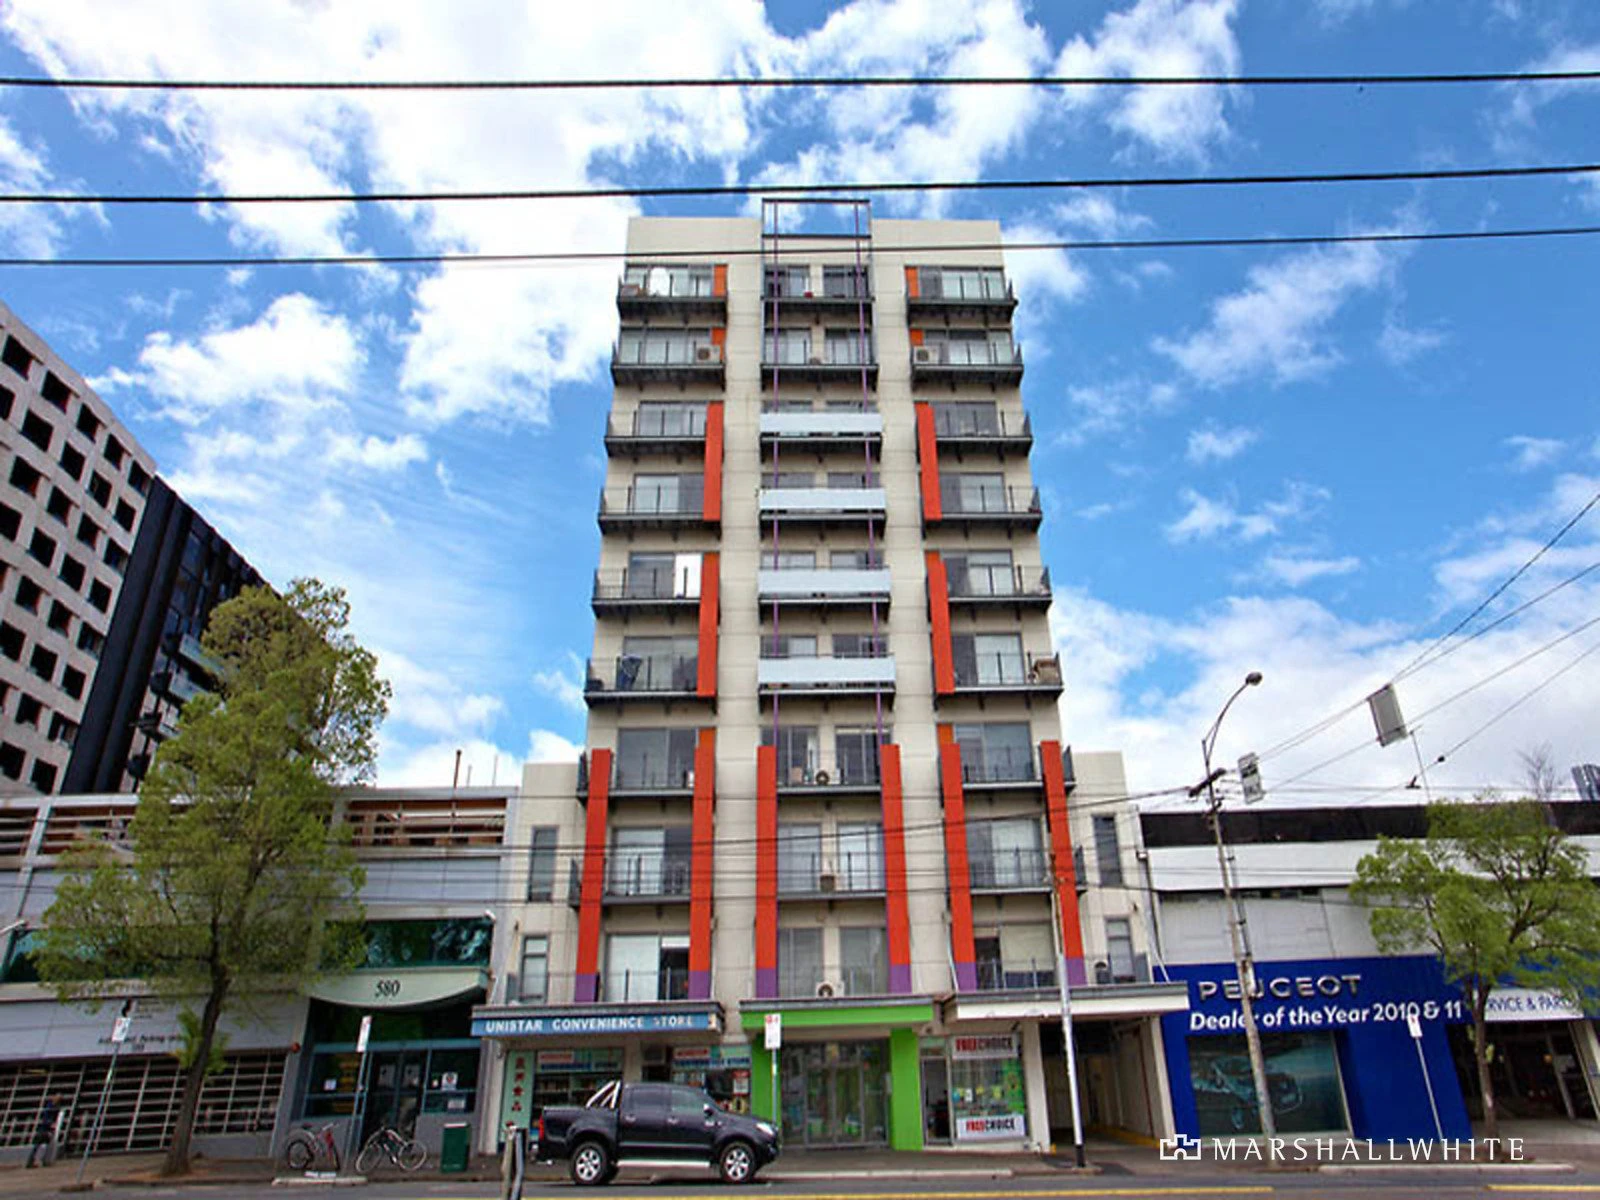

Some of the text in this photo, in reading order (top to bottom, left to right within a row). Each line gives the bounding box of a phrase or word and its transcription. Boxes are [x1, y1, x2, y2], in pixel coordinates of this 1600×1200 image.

[375, 979, 401, 998] 580
[485, 1019, 543, 1033] UNISTAR
[552, 1016, 644, 1031] CONVENIENCE
[1190, 1000, 1462, 1031] Deale of the Year 2010 & 11
